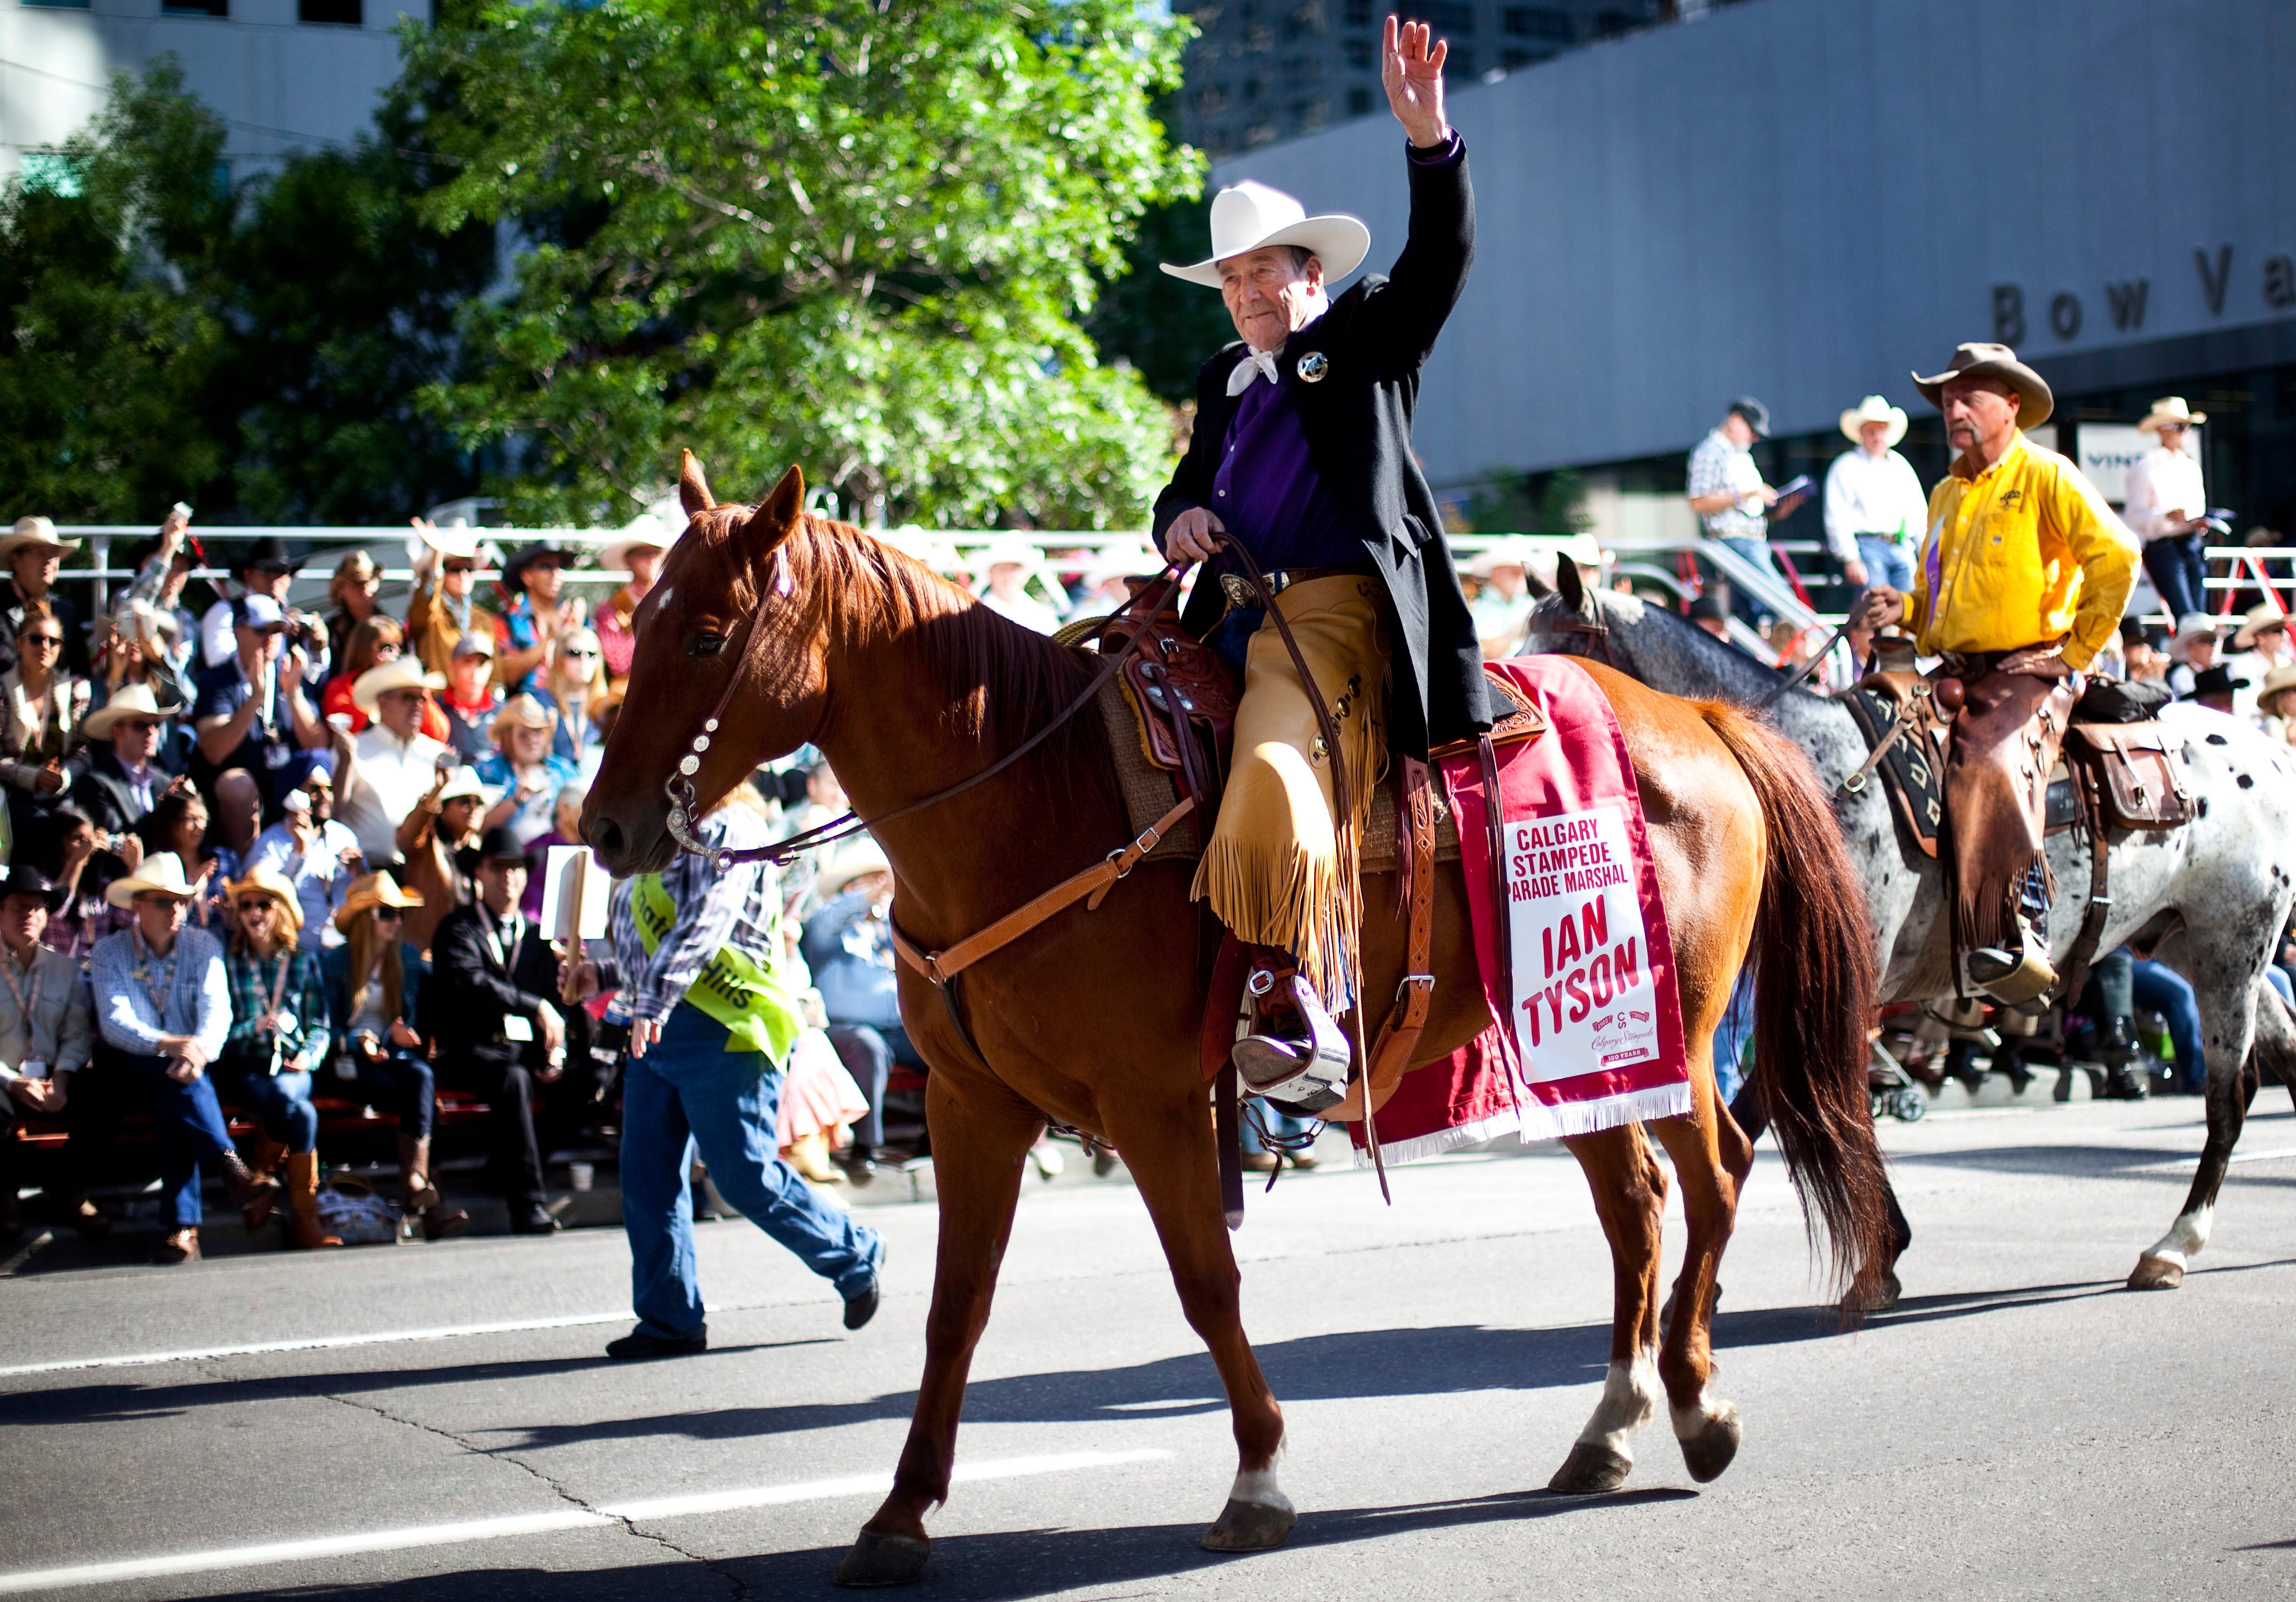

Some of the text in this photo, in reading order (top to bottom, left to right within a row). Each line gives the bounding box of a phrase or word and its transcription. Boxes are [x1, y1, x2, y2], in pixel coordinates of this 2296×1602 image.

[1517, 819, 1598, 851] CALGARY
[1513, 842, 1611, 877] STAMPEDE
[1564, 864, 1628, 893] MARSHAL
[1542, 894, 1608, 979] IAN
[1521, 936, 1639, 1047] TYSON
[1598, 1018, 1609, 1029] 1912
[1591, 1026, 1653, 1052] Calgary Stampede
[1620, 1050, 1641, 1058] YEARS
